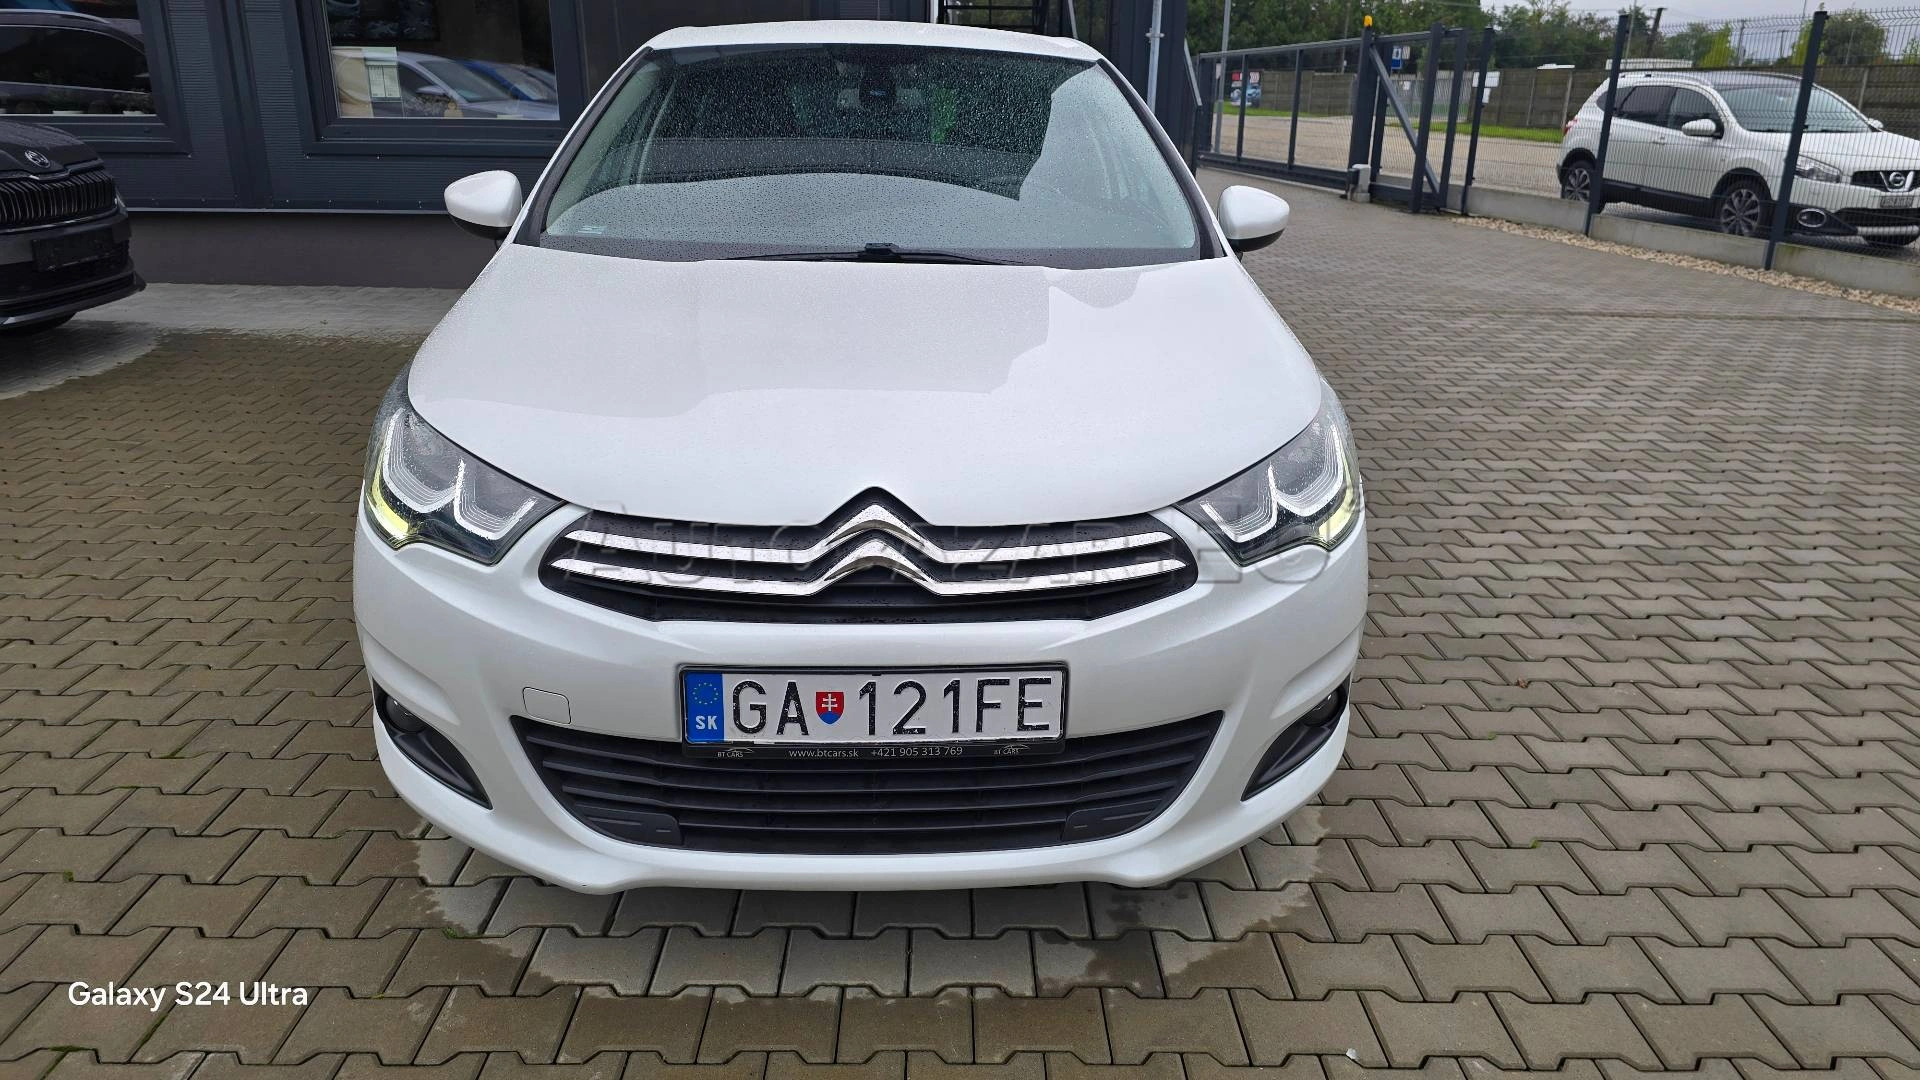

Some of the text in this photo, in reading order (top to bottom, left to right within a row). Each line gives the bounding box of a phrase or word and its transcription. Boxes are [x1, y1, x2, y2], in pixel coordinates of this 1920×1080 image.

[731, 676, 1053, 736] GA 121FE
[695, 715, 718, 731] SK
[788, 748, 859, 758] www.btcars.sk
[870, 746, 963, 757] +421 905 313 769
